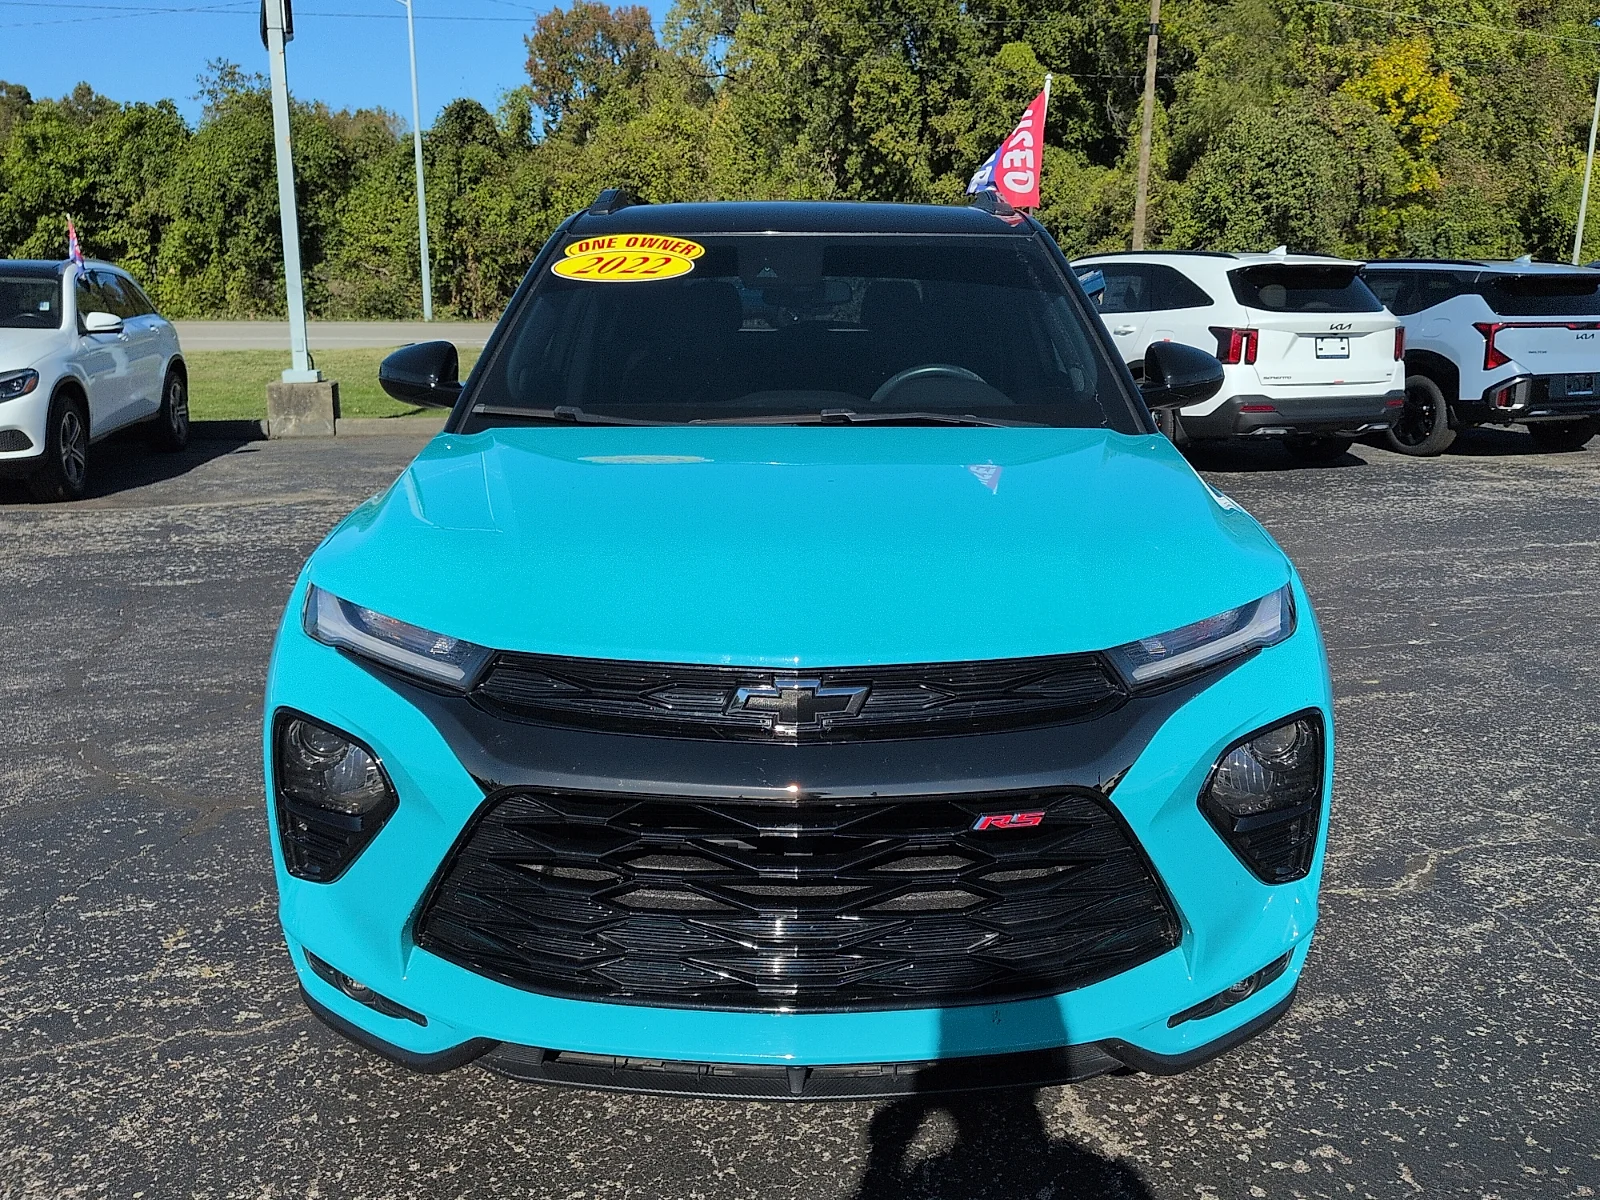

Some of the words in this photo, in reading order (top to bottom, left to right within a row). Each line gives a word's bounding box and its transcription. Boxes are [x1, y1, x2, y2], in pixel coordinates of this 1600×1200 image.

[578, 237, 618, 253] ONE
[625, 236, 697, 256] OWNER
[571, 256, 672, 275] 2022
[974, 811, 1046, 830] RS
